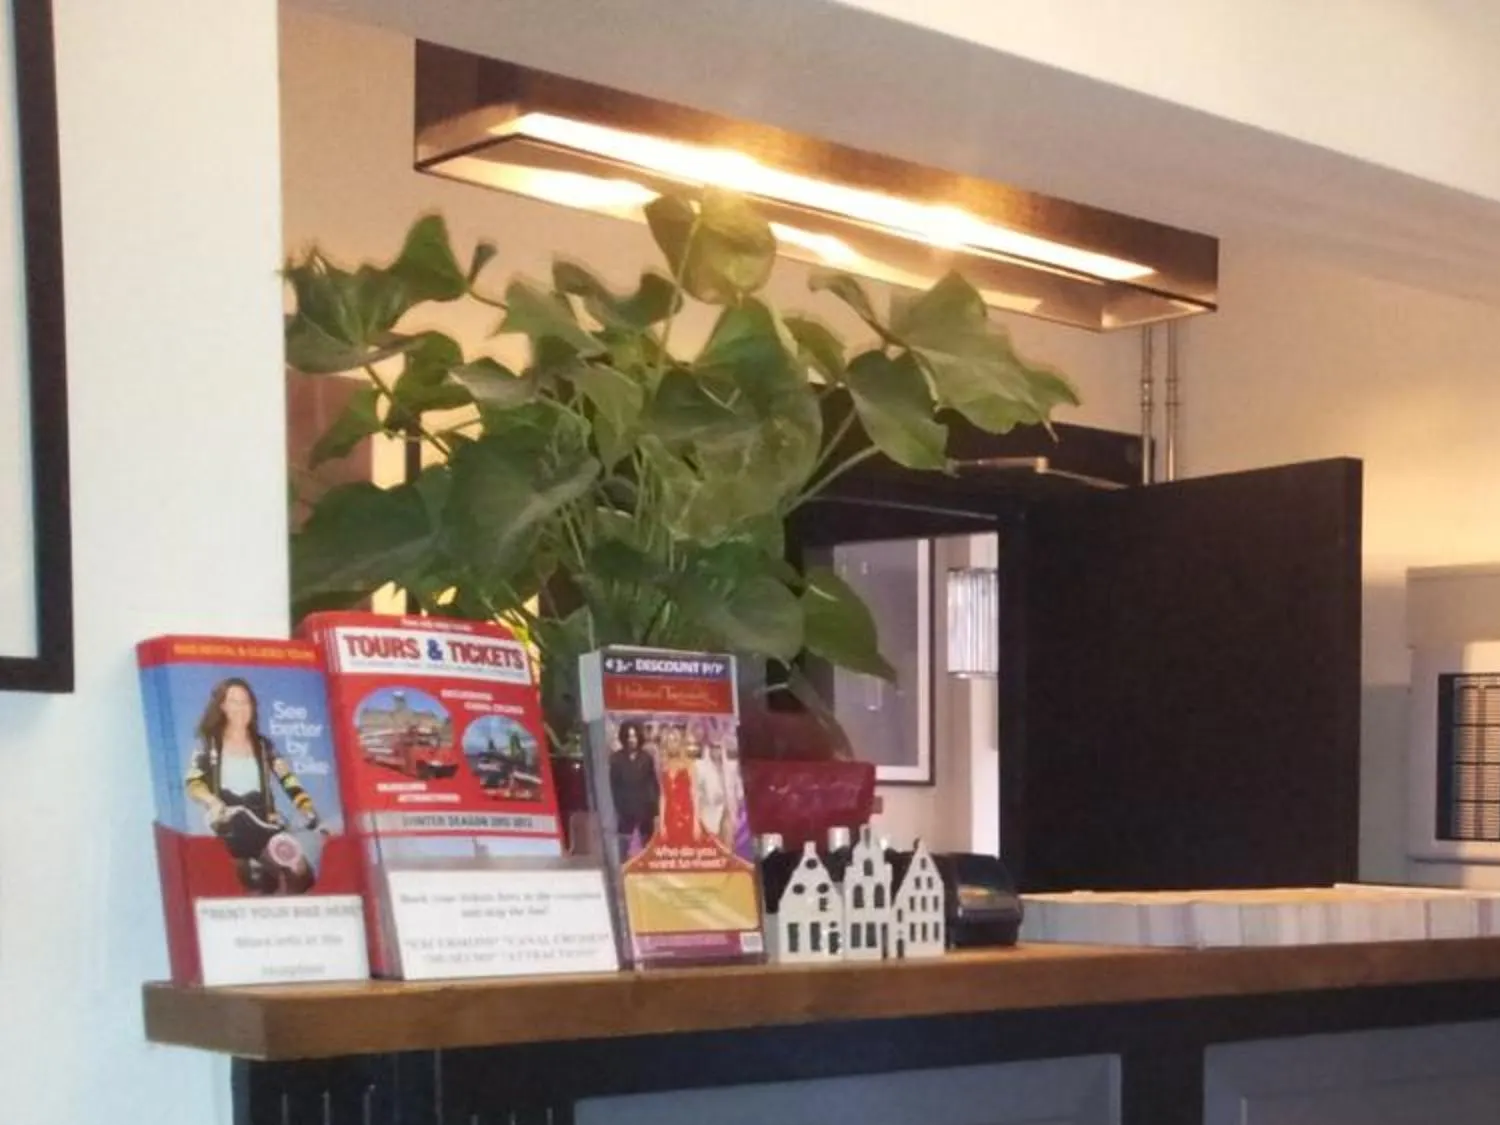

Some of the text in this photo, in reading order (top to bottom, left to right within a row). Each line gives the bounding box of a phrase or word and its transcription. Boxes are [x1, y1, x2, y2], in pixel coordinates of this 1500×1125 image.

[343, 633, 420, 661] TOURS
[427, 638, 444, 661] &
[447, 639, 525, 671] TICKETS
[635, 658, 699, 674] DISCOUNT
[272, 701, 307, 720] See
[270, 717, 322, 737] better
[286, 736, 308, 757] by
[655, 845, 717, 860] who do you
[648, 859, 675, 870] want
